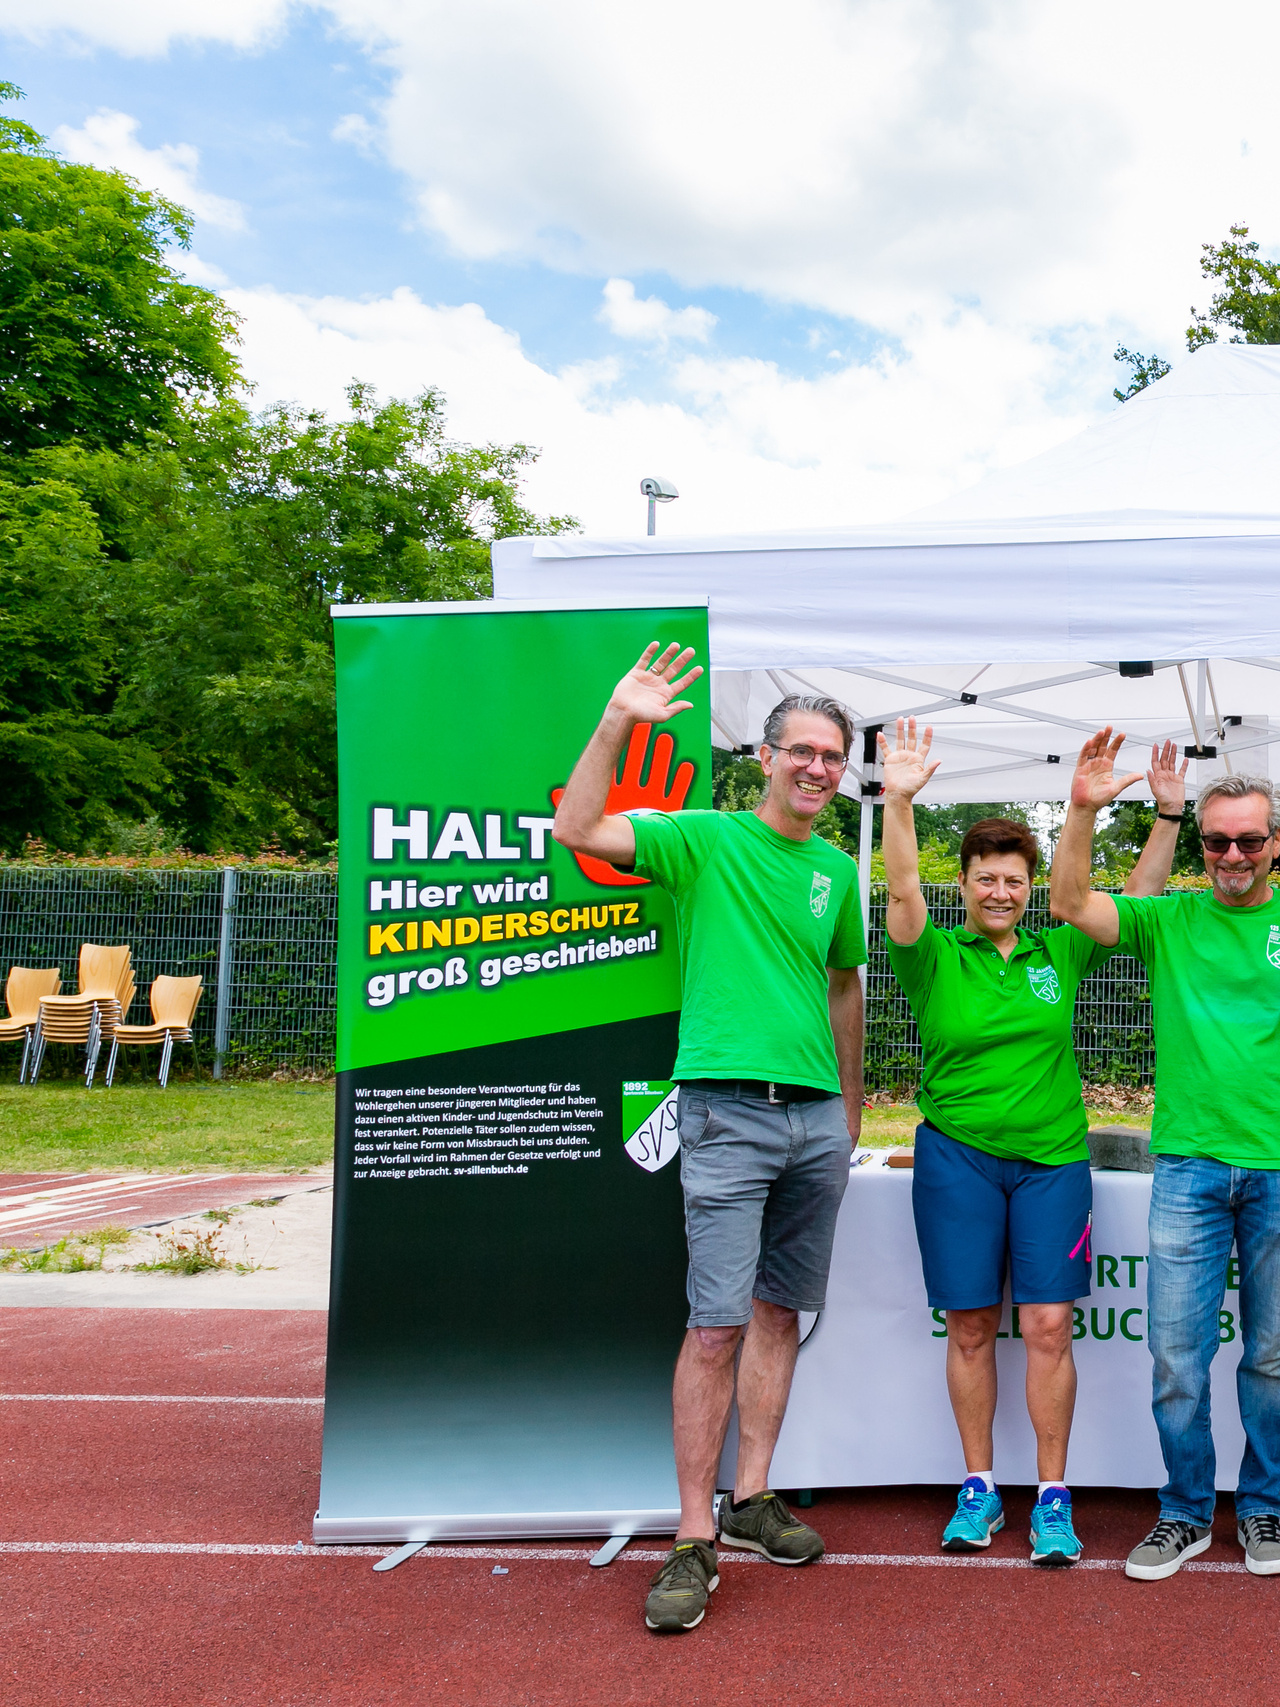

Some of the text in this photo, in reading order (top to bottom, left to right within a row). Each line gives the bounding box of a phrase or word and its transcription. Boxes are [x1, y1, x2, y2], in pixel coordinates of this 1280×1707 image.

[371, 807, 554, 860] HALT
[369, 876, 549, 911] Hier wird
[369, 902, 640, 955] KINDERSCHUTZ
[367, 930, 657, 1007] groß geschrieben!
[1042, 975, 1059, 1000] SVS
[355, 1082, 581, 1099] Wir tragen eine besondere Verantwortung für das
[623, 1081, 649, 1091] 1892
[354, 1094, 597, 1113] Wohlergehen unserer jüngeren Mitglieder und haben
[354, 1108, 604, 1125] dazu einen aktiven Kinder- und Jugendschutz im Verein
[354, 1122, 596, 1139] fest verankert. Potenzielle Täter sollen zudem wissen,
[637, 1100, 678, 1162] SVS
[354, 1135, 590, 1152] dass wir keine Form von Missbrauch bei uns dulden.
[353, 1148, 601, 1166] Jeder Vorfall wird im Rahmen der Gesetze verfolgt und
[353, 1163, 529, 1180] zur Anzeige gebracht. sv-sillenbuch.de
